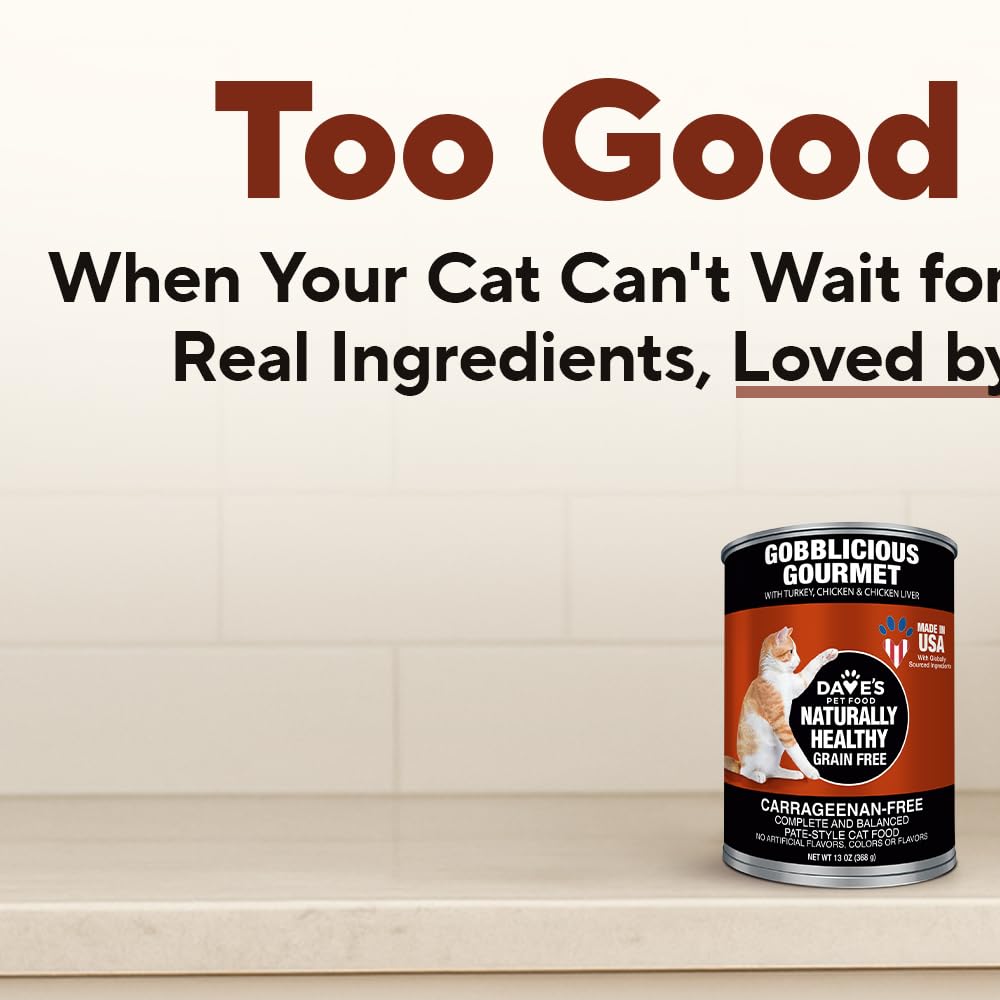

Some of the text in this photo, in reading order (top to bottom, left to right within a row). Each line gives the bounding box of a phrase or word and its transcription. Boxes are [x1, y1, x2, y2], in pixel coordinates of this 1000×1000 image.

[765, 539, 919, 564] GOBBLICIOUS
[783, 563, 901, 585] GOURMET
[764, 587, 920, 600] WITH TURKEY, CHICKEN & CHICKEN LIVER
[917, 622, 937, 634] MADE
[918, 633, 945, 653] USA
[908, 660, 930, 668] Sourced
[817, 678, 885, 696] DAVE'S
[800, 706, 898, 726] NATURALLY
[811, 729, 889, 749] HEALTHY
[813, 752, 887, 766] GRAIN FREE
[761, 798, 924, 817] CARRAGEENAN-FREE
[774, 815, 909, 829] COMPLETE AND BALANCED
[755, 832, 766, 841] NO
[766, 834, 805, 847] ARTIFICIAL
[848, 839, 883, 849] COLORS
[884, 838, 896, 846] OR
[897, 832, 928, 845] FLAVORS
[784, 827, 900, 840] PATE-STYLE CAT FOOD
[807, 853, 820, 861] NET
[821, 854, 832, 862] WT
[834, 854, 842, 862] 13
[843, 854, 853, 862] OZ
[869, 853, 877, 863] g)
